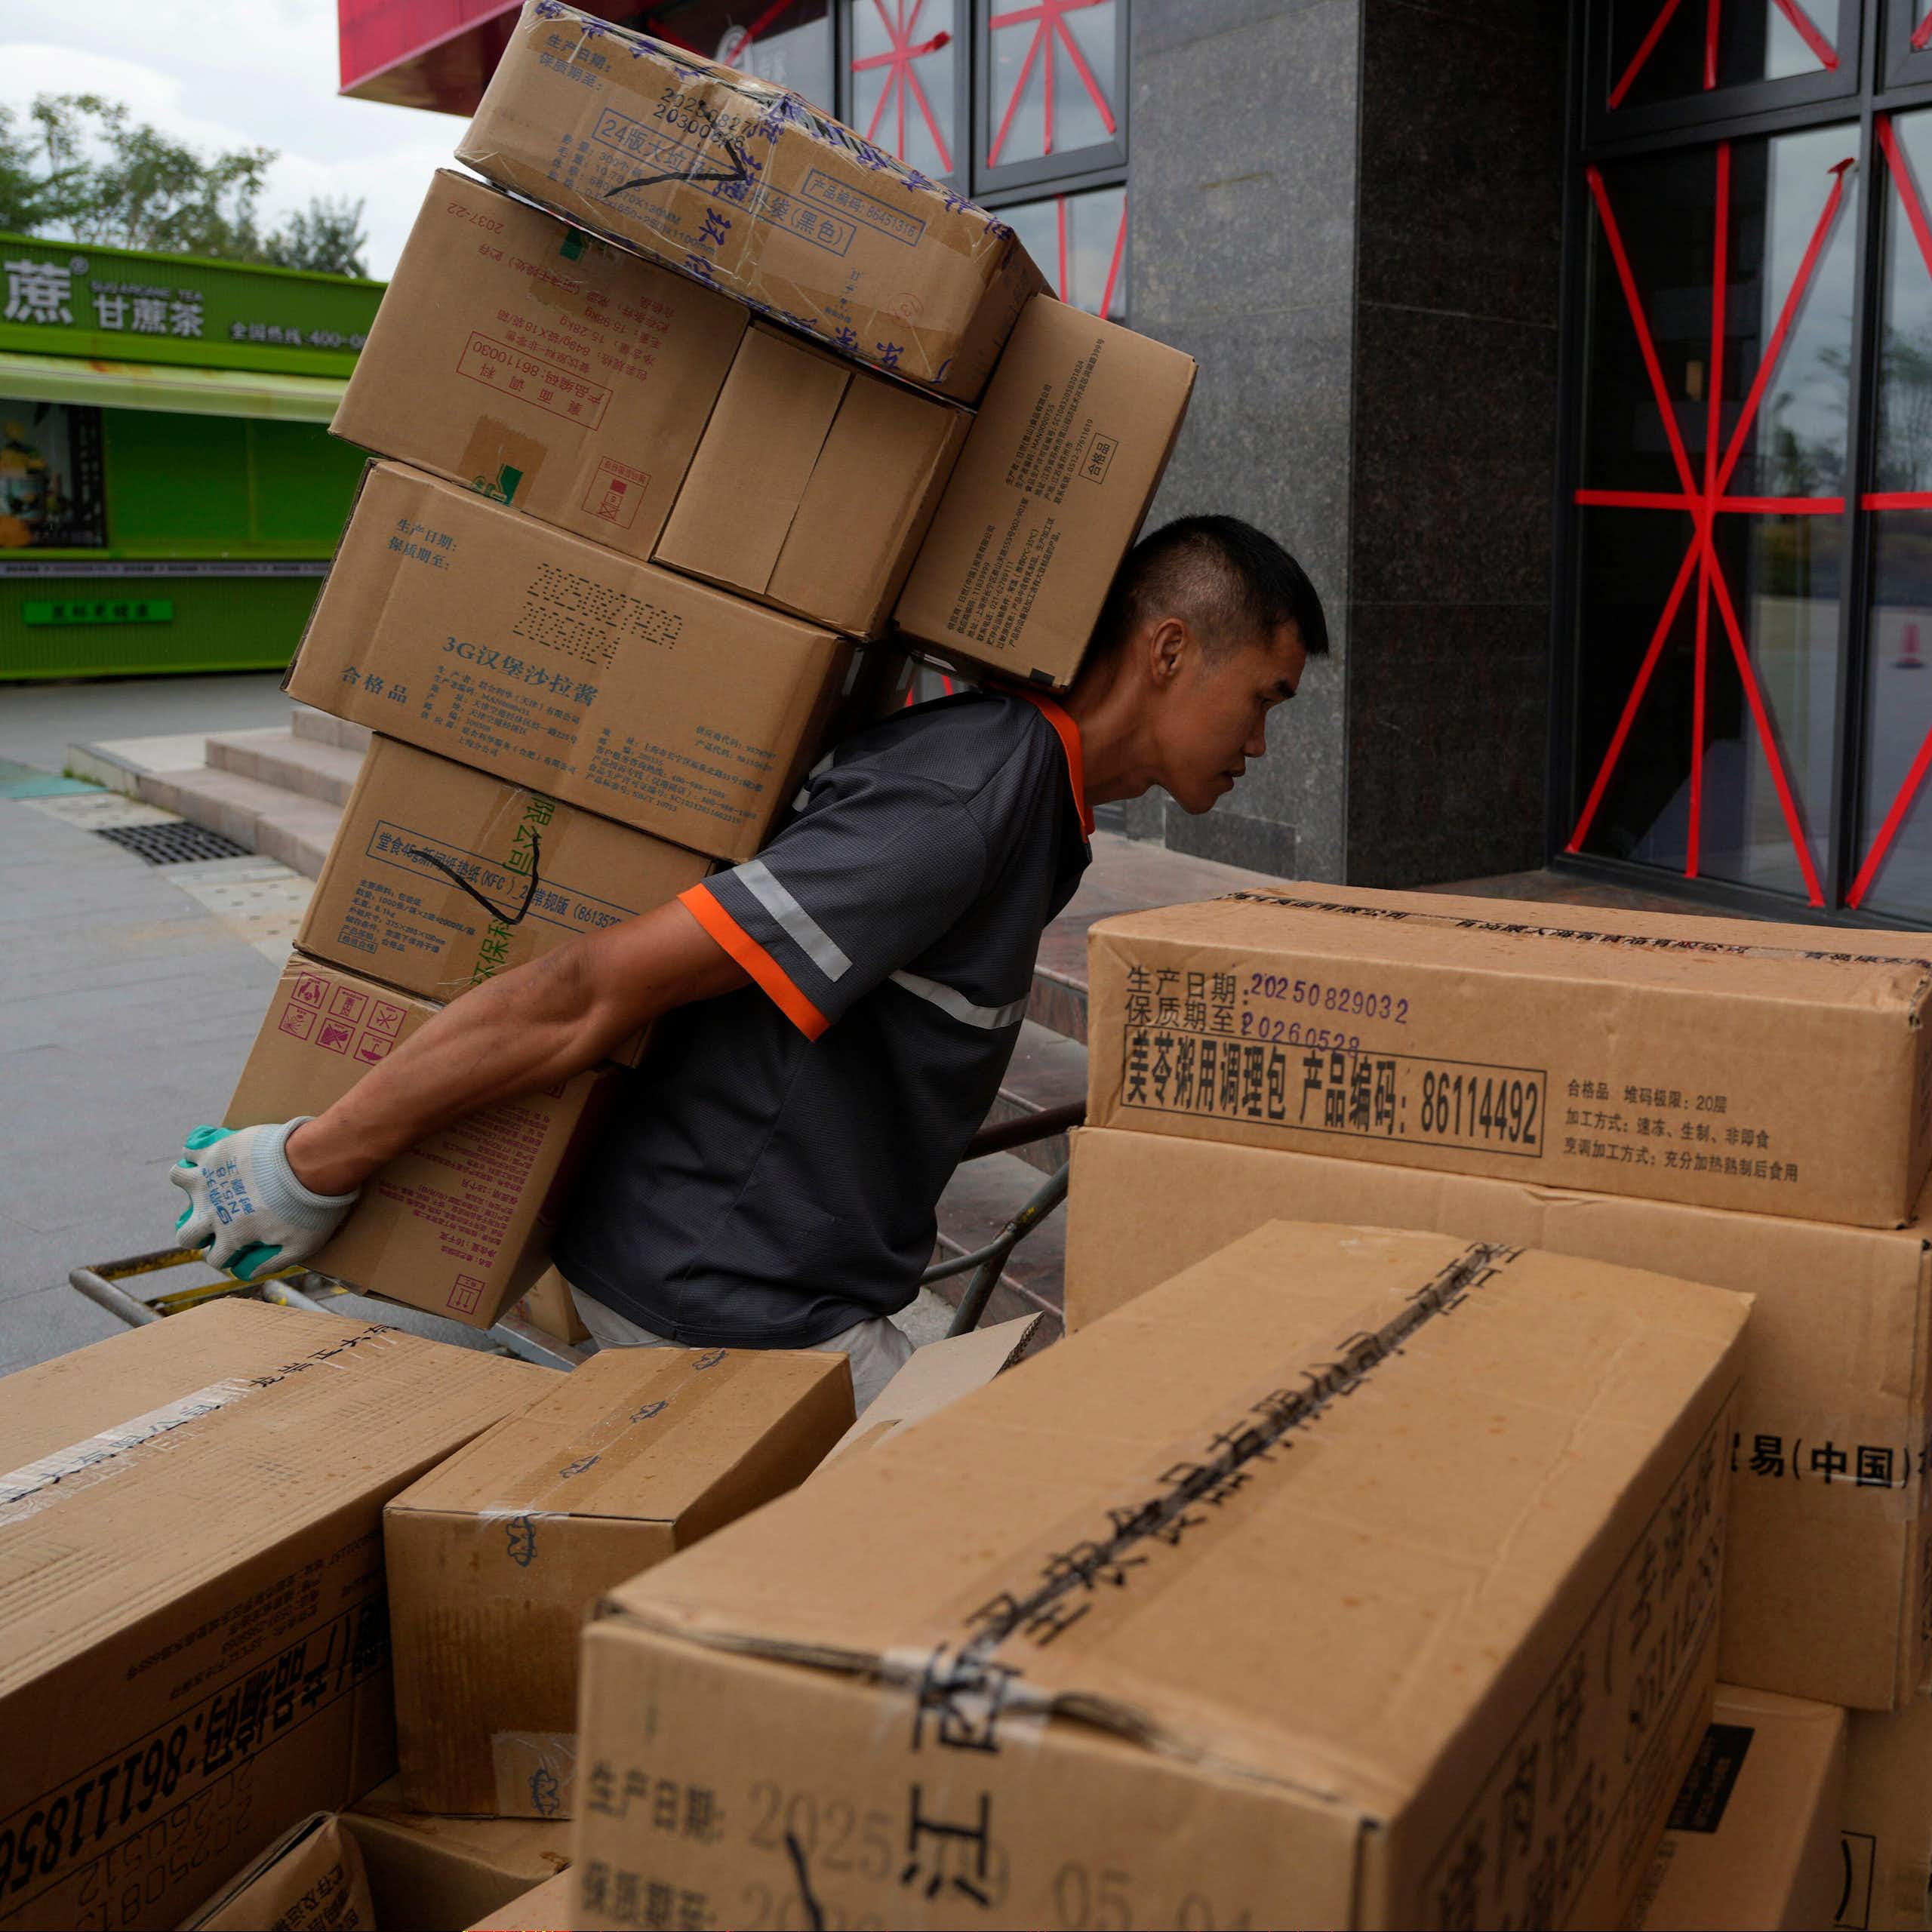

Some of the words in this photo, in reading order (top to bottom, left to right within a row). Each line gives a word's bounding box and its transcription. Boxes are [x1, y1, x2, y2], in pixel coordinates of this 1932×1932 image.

[4, 259, 74, 324] 蔗
[93, 294, 204, 337] 甘蔗茶
[1086, 441, 1111, 477] 合格品
[341, 666, 409, 706] 合格品
[442, 636, 598, 707] 3G汉堡沙拉酱
[1251, 972, 1409, 1024] 20250829032
[1567, 1079, 1609, 1101] 合格品
